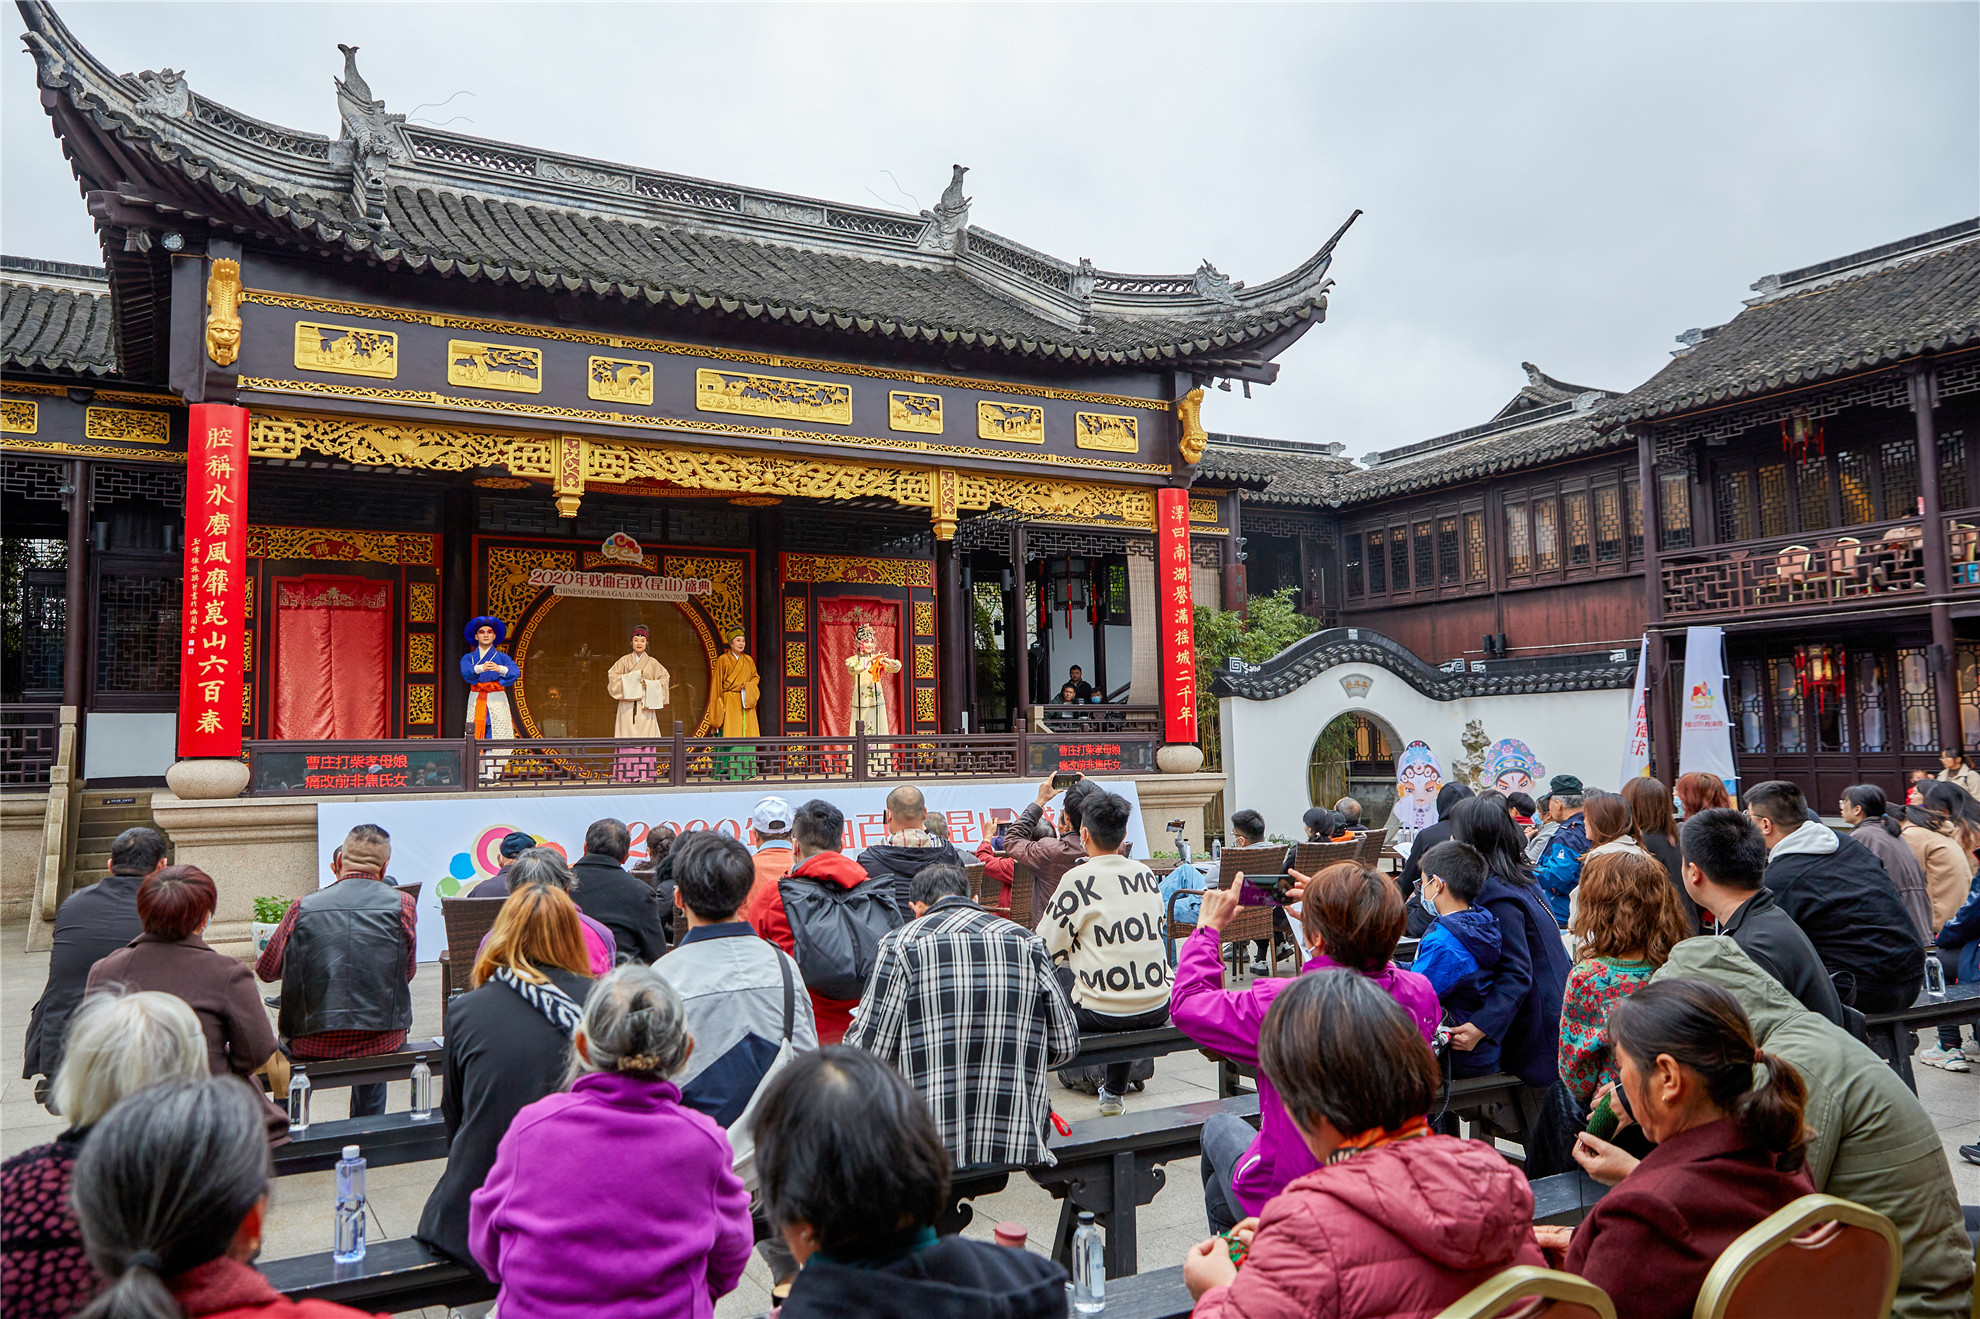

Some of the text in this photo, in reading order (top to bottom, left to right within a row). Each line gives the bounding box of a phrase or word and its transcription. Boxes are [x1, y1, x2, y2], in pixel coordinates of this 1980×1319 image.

[554, 587, 587, 596] CHINESE
[587, 588, 612, 597] OPERA
[305, 754, 408, 770] 曹庄打柴孝母娘
[304, 773, 408, 789] 痛改前非焦氏女
